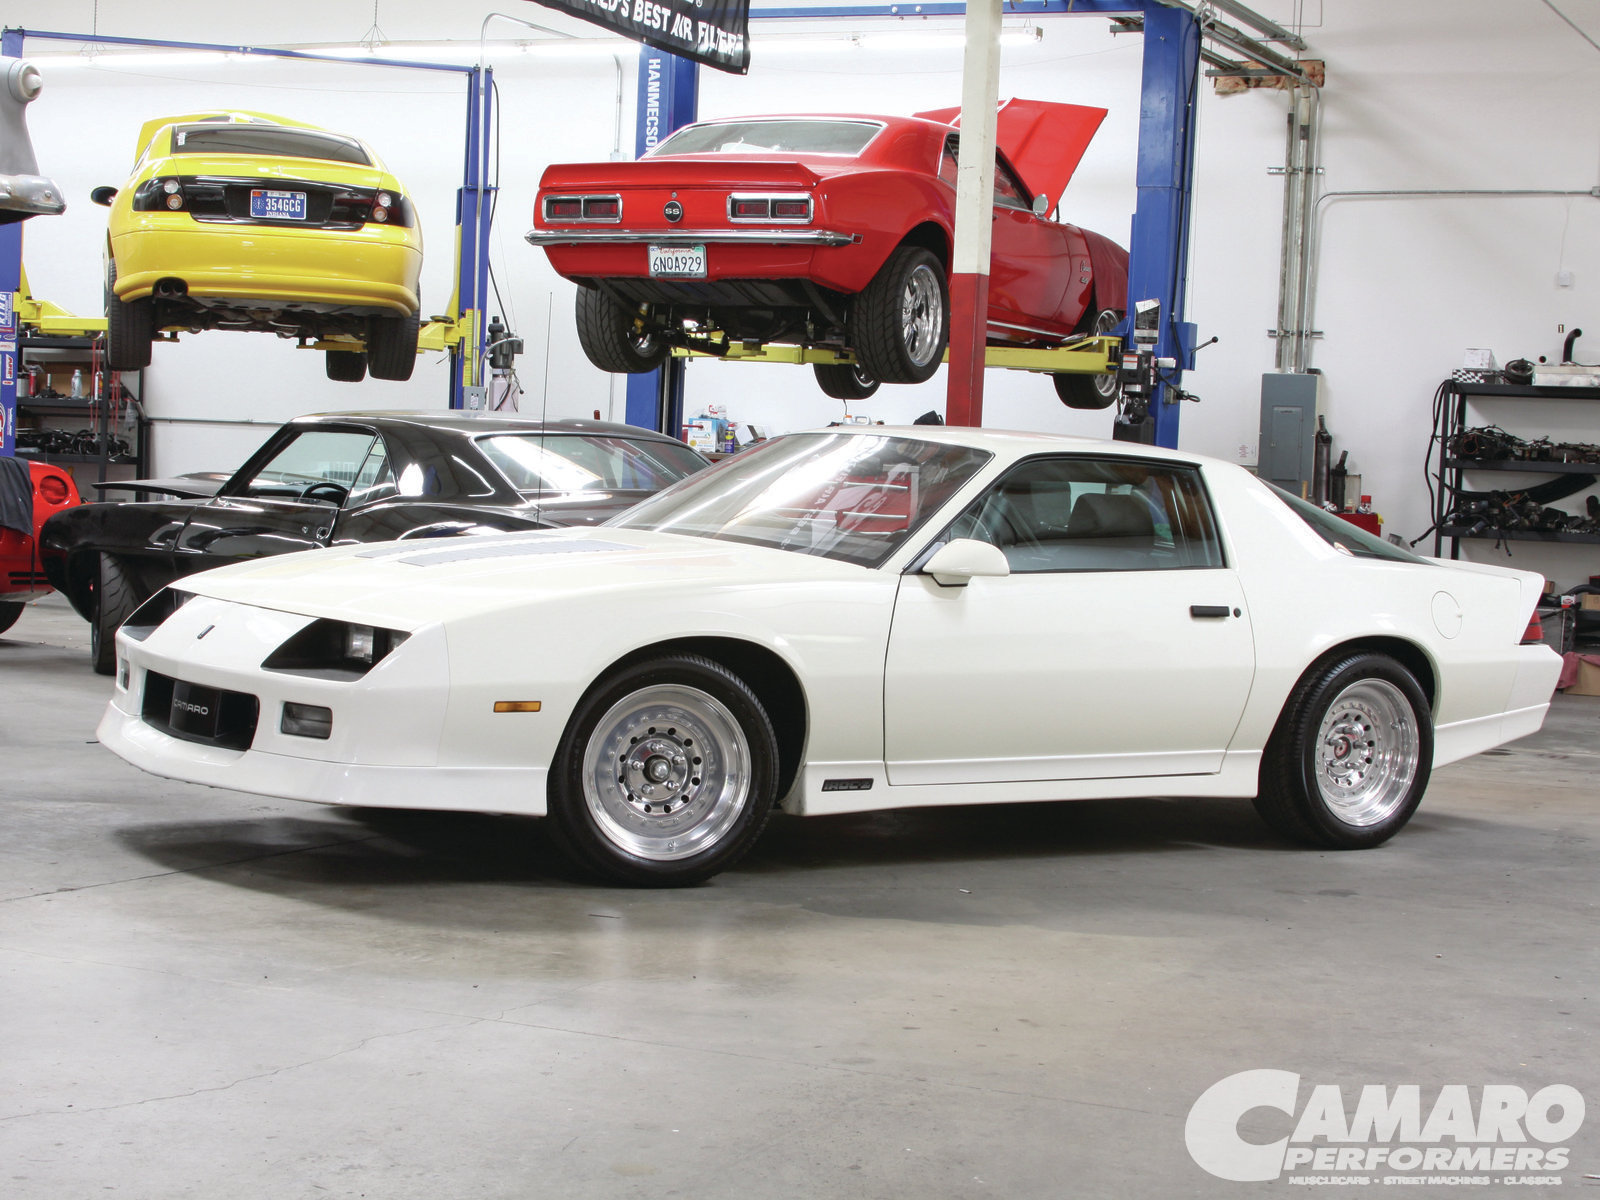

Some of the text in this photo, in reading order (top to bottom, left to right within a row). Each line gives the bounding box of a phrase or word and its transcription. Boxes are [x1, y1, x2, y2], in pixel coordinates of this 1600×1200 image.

[632, 2, 671, 32] BEST
[670, 13, 693, 41] AIR
[265, 198, 301, 212] 354GCG
[665, 207, 680, 215] SS
[173, 699, 209, 715] CAMARO
